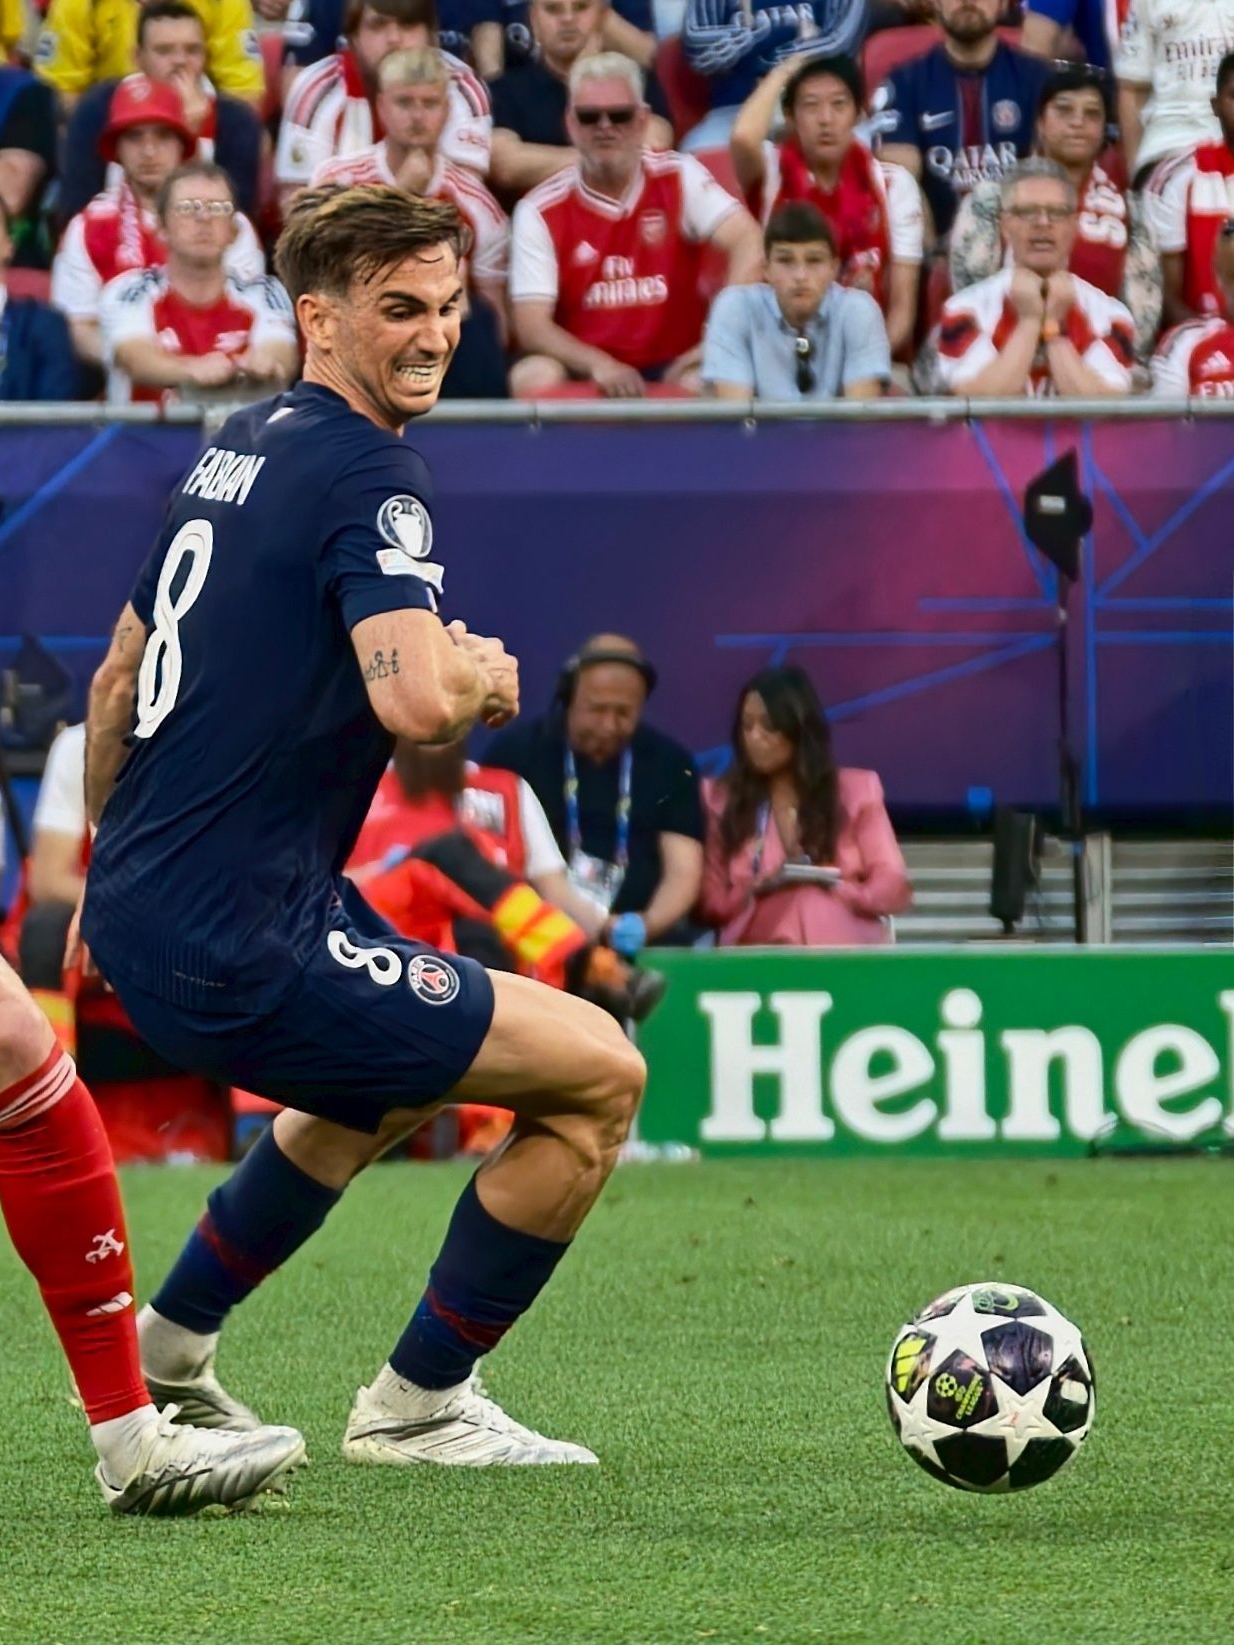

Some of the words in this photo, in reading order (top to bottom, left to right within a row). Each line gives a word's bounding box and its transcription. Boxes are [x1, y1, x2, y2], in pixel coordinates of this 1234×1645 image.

[927, 141, 1017, 176] QATAR
[133, 518, 214, 740] 8
[326, 929, 403, 986] 8
[697, 986, 1234, 1144] Heine
